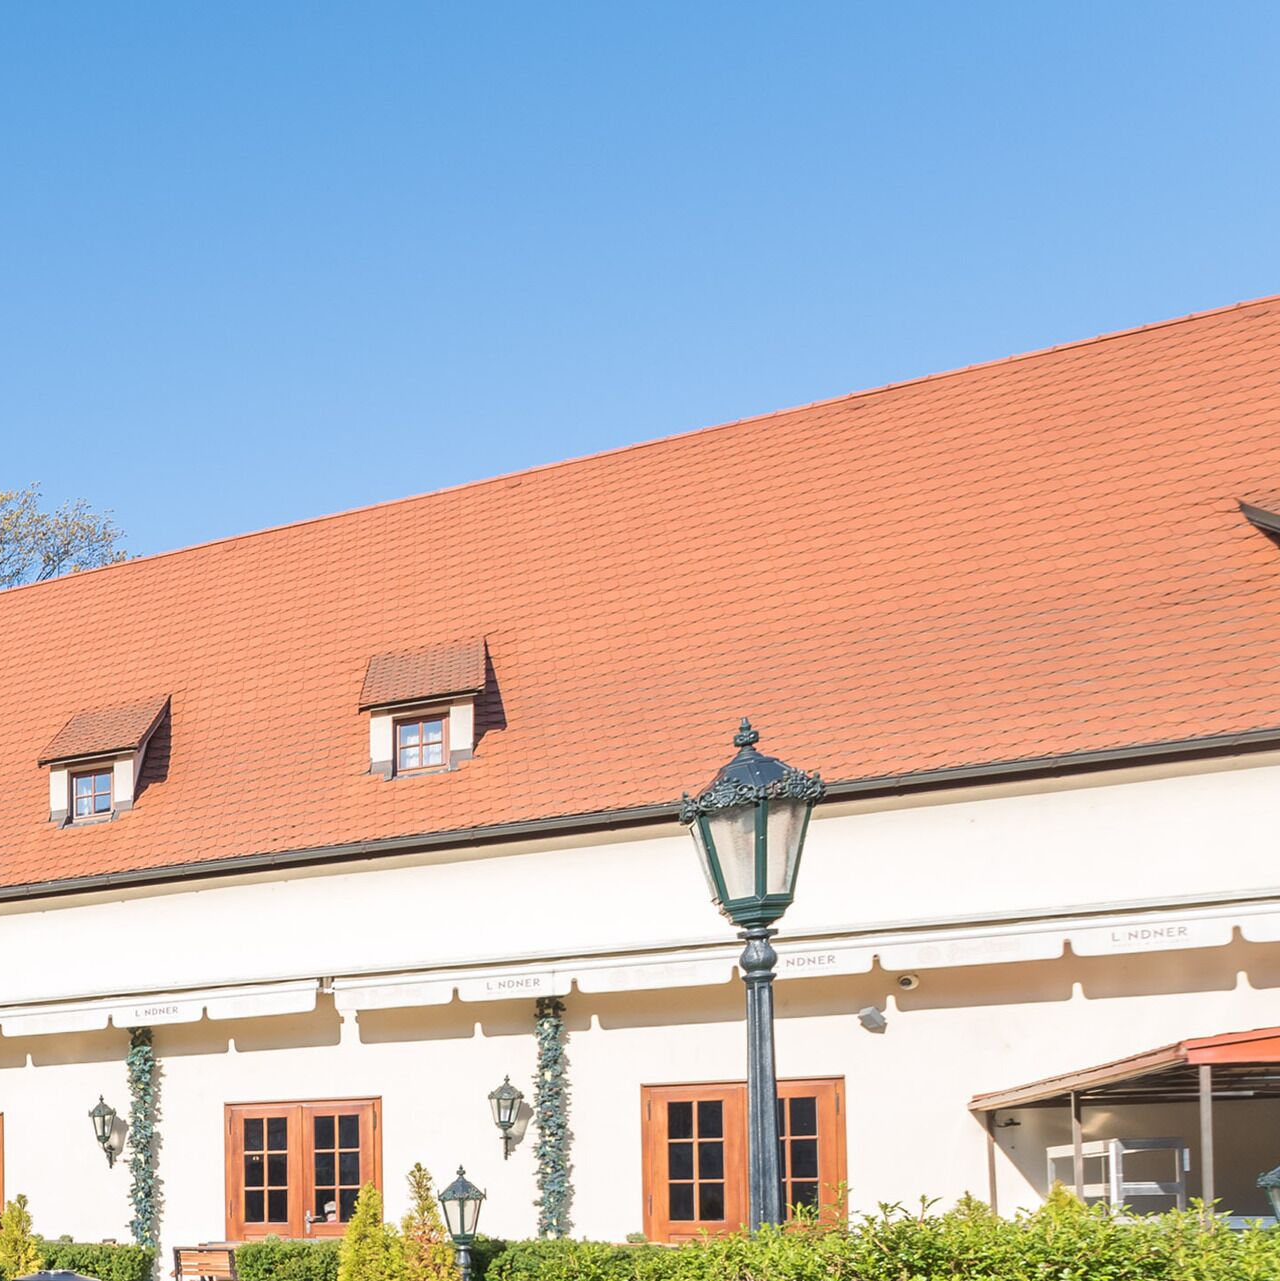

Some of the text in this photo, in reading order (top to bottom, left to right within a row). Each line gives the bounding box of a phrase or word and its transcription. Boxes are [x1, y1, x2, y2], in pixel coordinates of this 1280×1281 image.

[1111, 926, 1189, 942] LNDNER
[486, 977, 541, 991] LNDNER
[134, 1005, 179, 1017] LNDNER
